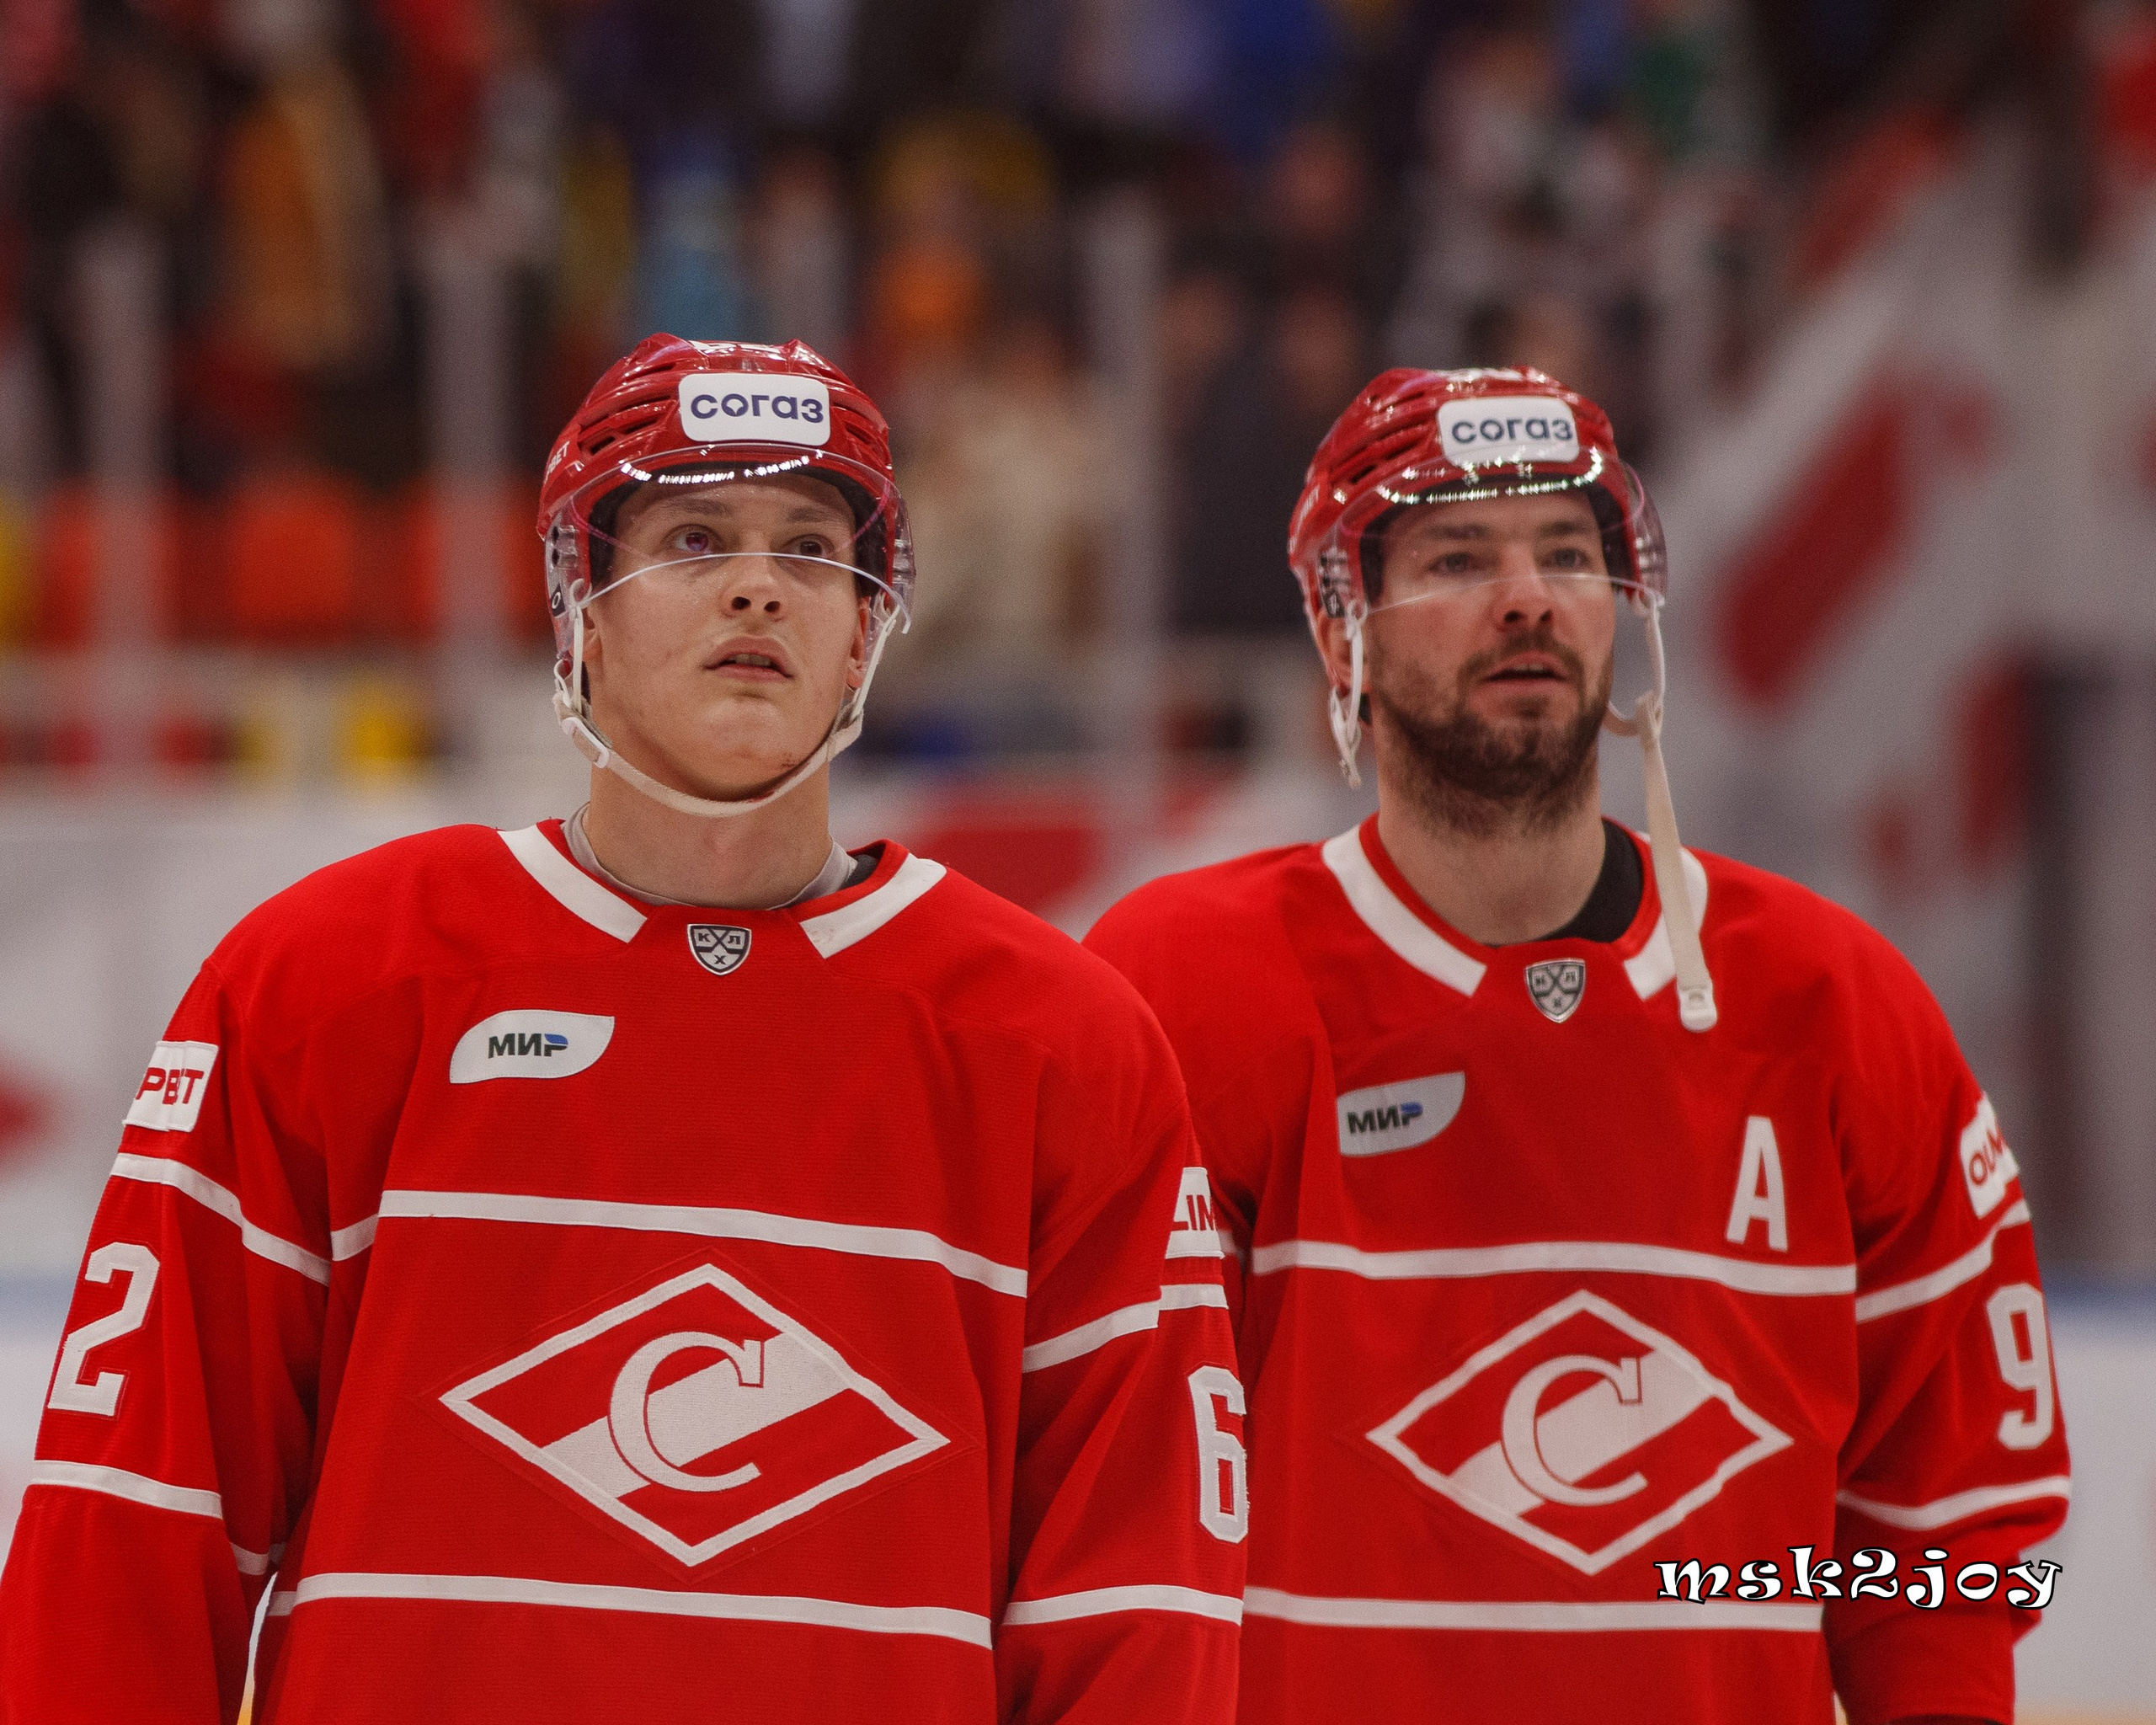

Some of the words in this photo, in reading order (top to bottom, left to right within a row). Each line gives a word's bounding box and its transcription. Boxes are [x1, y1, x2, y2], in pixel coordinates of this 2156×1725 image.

[690, 393, 825, 424] согаз
[1451, 418, 1574, 446] согаз
[488, 1033, 569, 1059] МИР
[1348, 1101, 1423, 1135] МИР
[1726, 1114, 1789, 1253] A
[47, 1242, 160, 1417] 2
[1986, 1283, 2055, 1450] 9
[1187, 1365, 1249, 1544] 6
